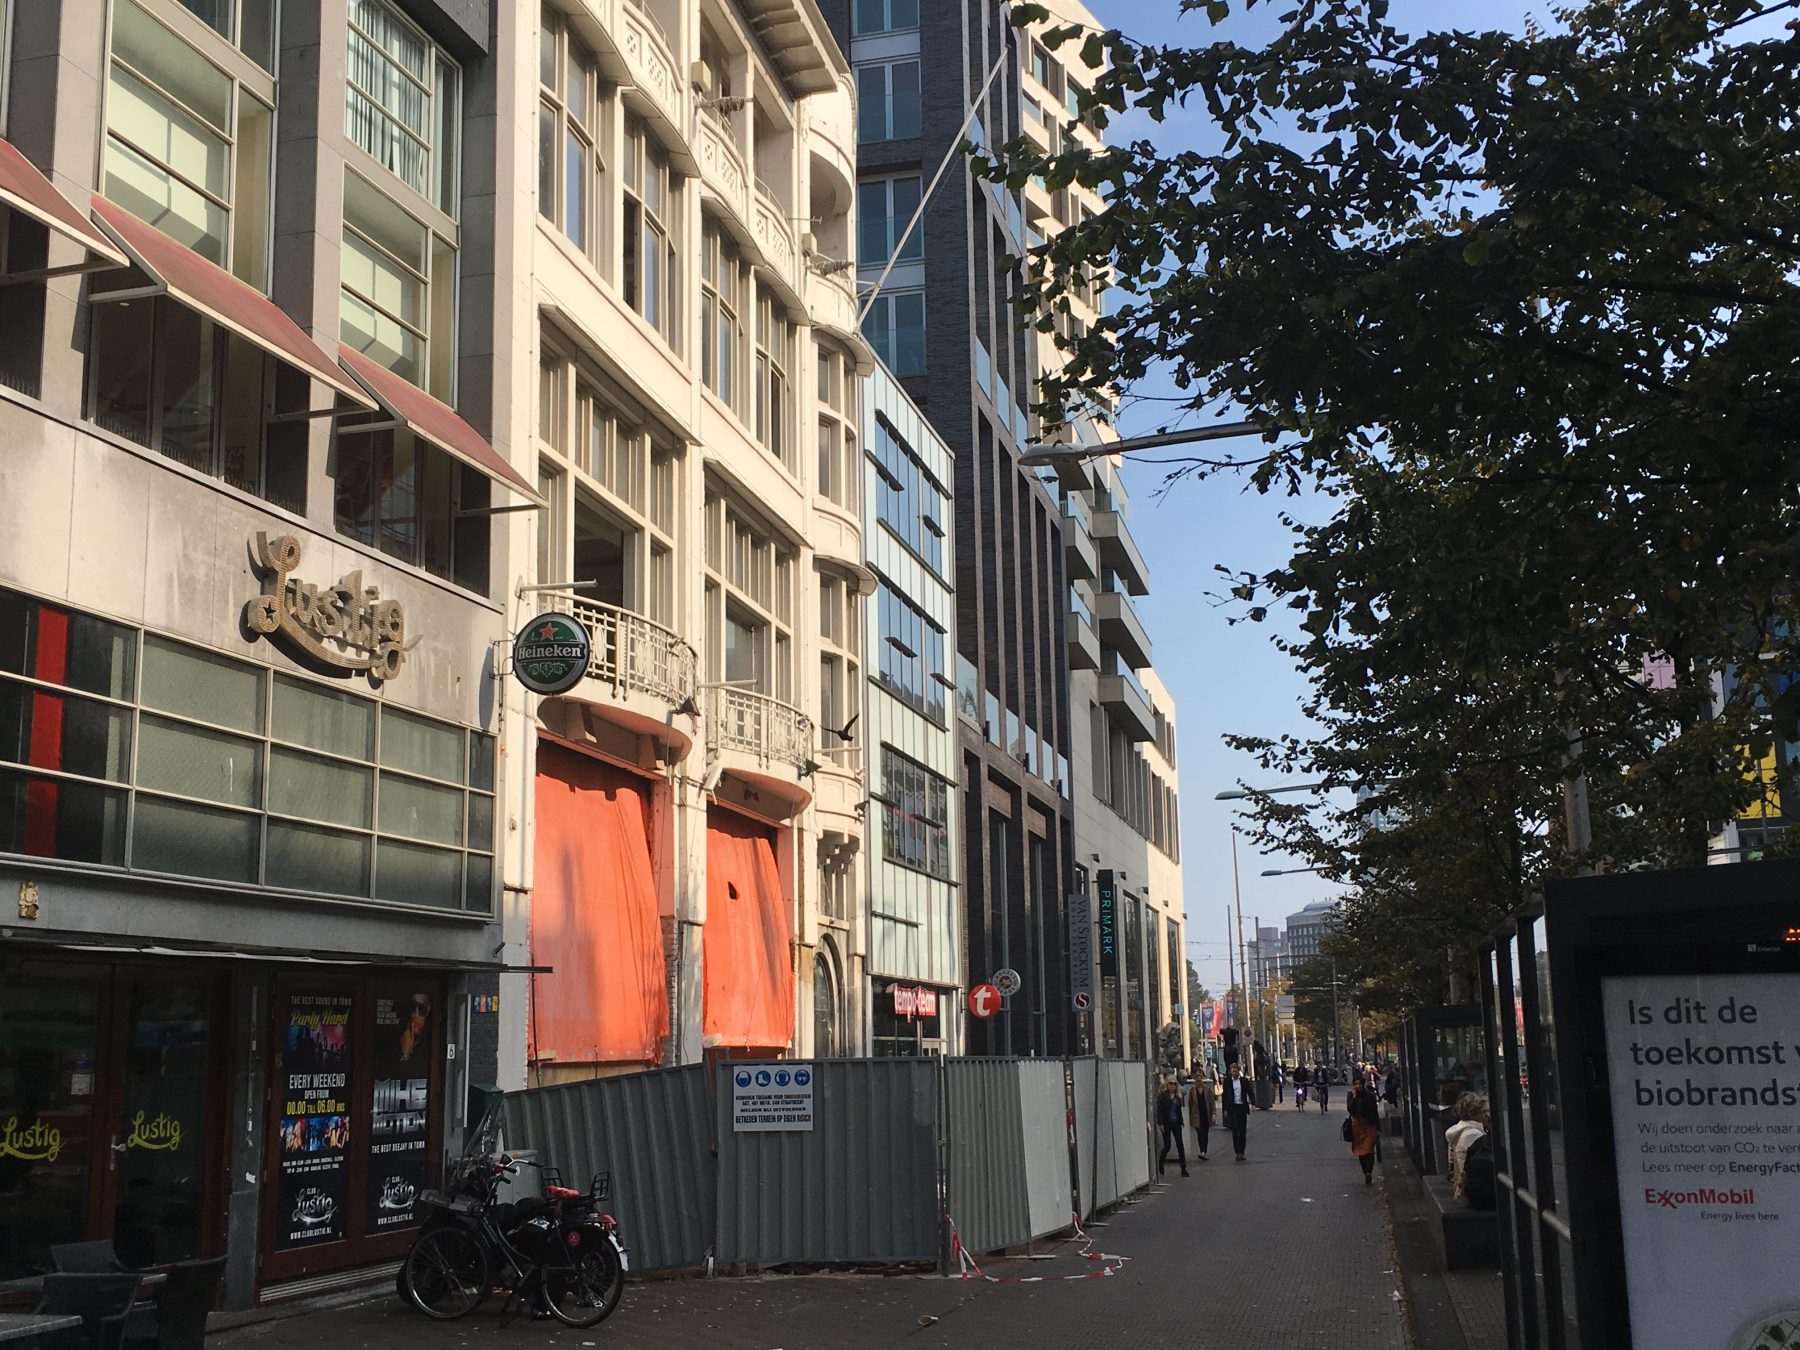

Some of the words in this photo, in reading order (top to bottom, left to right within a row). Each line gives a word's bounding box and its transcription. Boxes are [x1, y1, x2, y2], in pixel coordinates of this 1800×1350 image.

[247, 531, 415, 681] Lustig
[518, 644, 582, 660] Heineken
[1077, 900, 1087, 923] VAN
[1101, 890, 1113, 954] PRIMARK
[1078, 926, 1091, 988] STOCKUM
[291, 995, 301, 1005] THE
[302, 995, 314, 1005] BEST
[894, 983, 937, 1023] tempo-team
[974, 985, 991, 1017] t
[1628, 999, 1654, 1025] Is
[1663, 996, 1708, 1025] dit
[1717, 995, 1758, 1024] de
[290, 1008, 321, 1031] Party
[322, 1007, 351, 1025] Hard
[448, 1044, 454, 1058] 6
[1630, 1037, 1786, 1066] toekomst
[289, 1074, 312, 1089] EVERY
[312, 1072, 346, 1088] WEEKEND
[1635, 1078, 1800, 1106] biobrands
[304, 1090, 316, 1100] OPEN
[317, 1089, 329, 1099] FROM
[287, 1101, 307, 1115] 00.00
[317, 1099, 336, 1113] 06.00
[127, 1109, 183, 1152] Lustig
[372, 1111, 427, 1135] MOTION
[1638, 1122, 1658, 1137] Wij
[1661, 1122, 1693, 1135] doen
[1696, 1123, 1763, 1135] onderzoek
[1766, 1124, 1794, 1134] naar
[0, 1114, 63, 1162] Lustig
[371, 1145, 380, 1154] THE
[380, 1144, 391, 1153] BEST
[392, 1142, 408, 1152] DEEJAY
[408, 1141, 413, 1150] IN
[414, 1140, 426, 1150] TOWN
[1640, 1141, 1656, 1154] de
[1659, 1142, 1706, 1154] uitstoot
[1708, 1145, 1731, 1154] van
[1763, 1143, 1775, 1154] te
[1642, 1161, 1671, 1173] Lees
[1674, 1163, 1705, 1173] meer
[1709, 1165, 1725, 1176] op
[291, 1187, 338, 1223] Lustig
[378, 1176, 419, 1210] Lustig
[1644, 1188, 1755, 1209] ExxonMobil
[1700, 1211, 1732, 1223] Energy
[1735, 1212, 1755, 1221] lives
[1758, 1212, 1779, 1221] here
